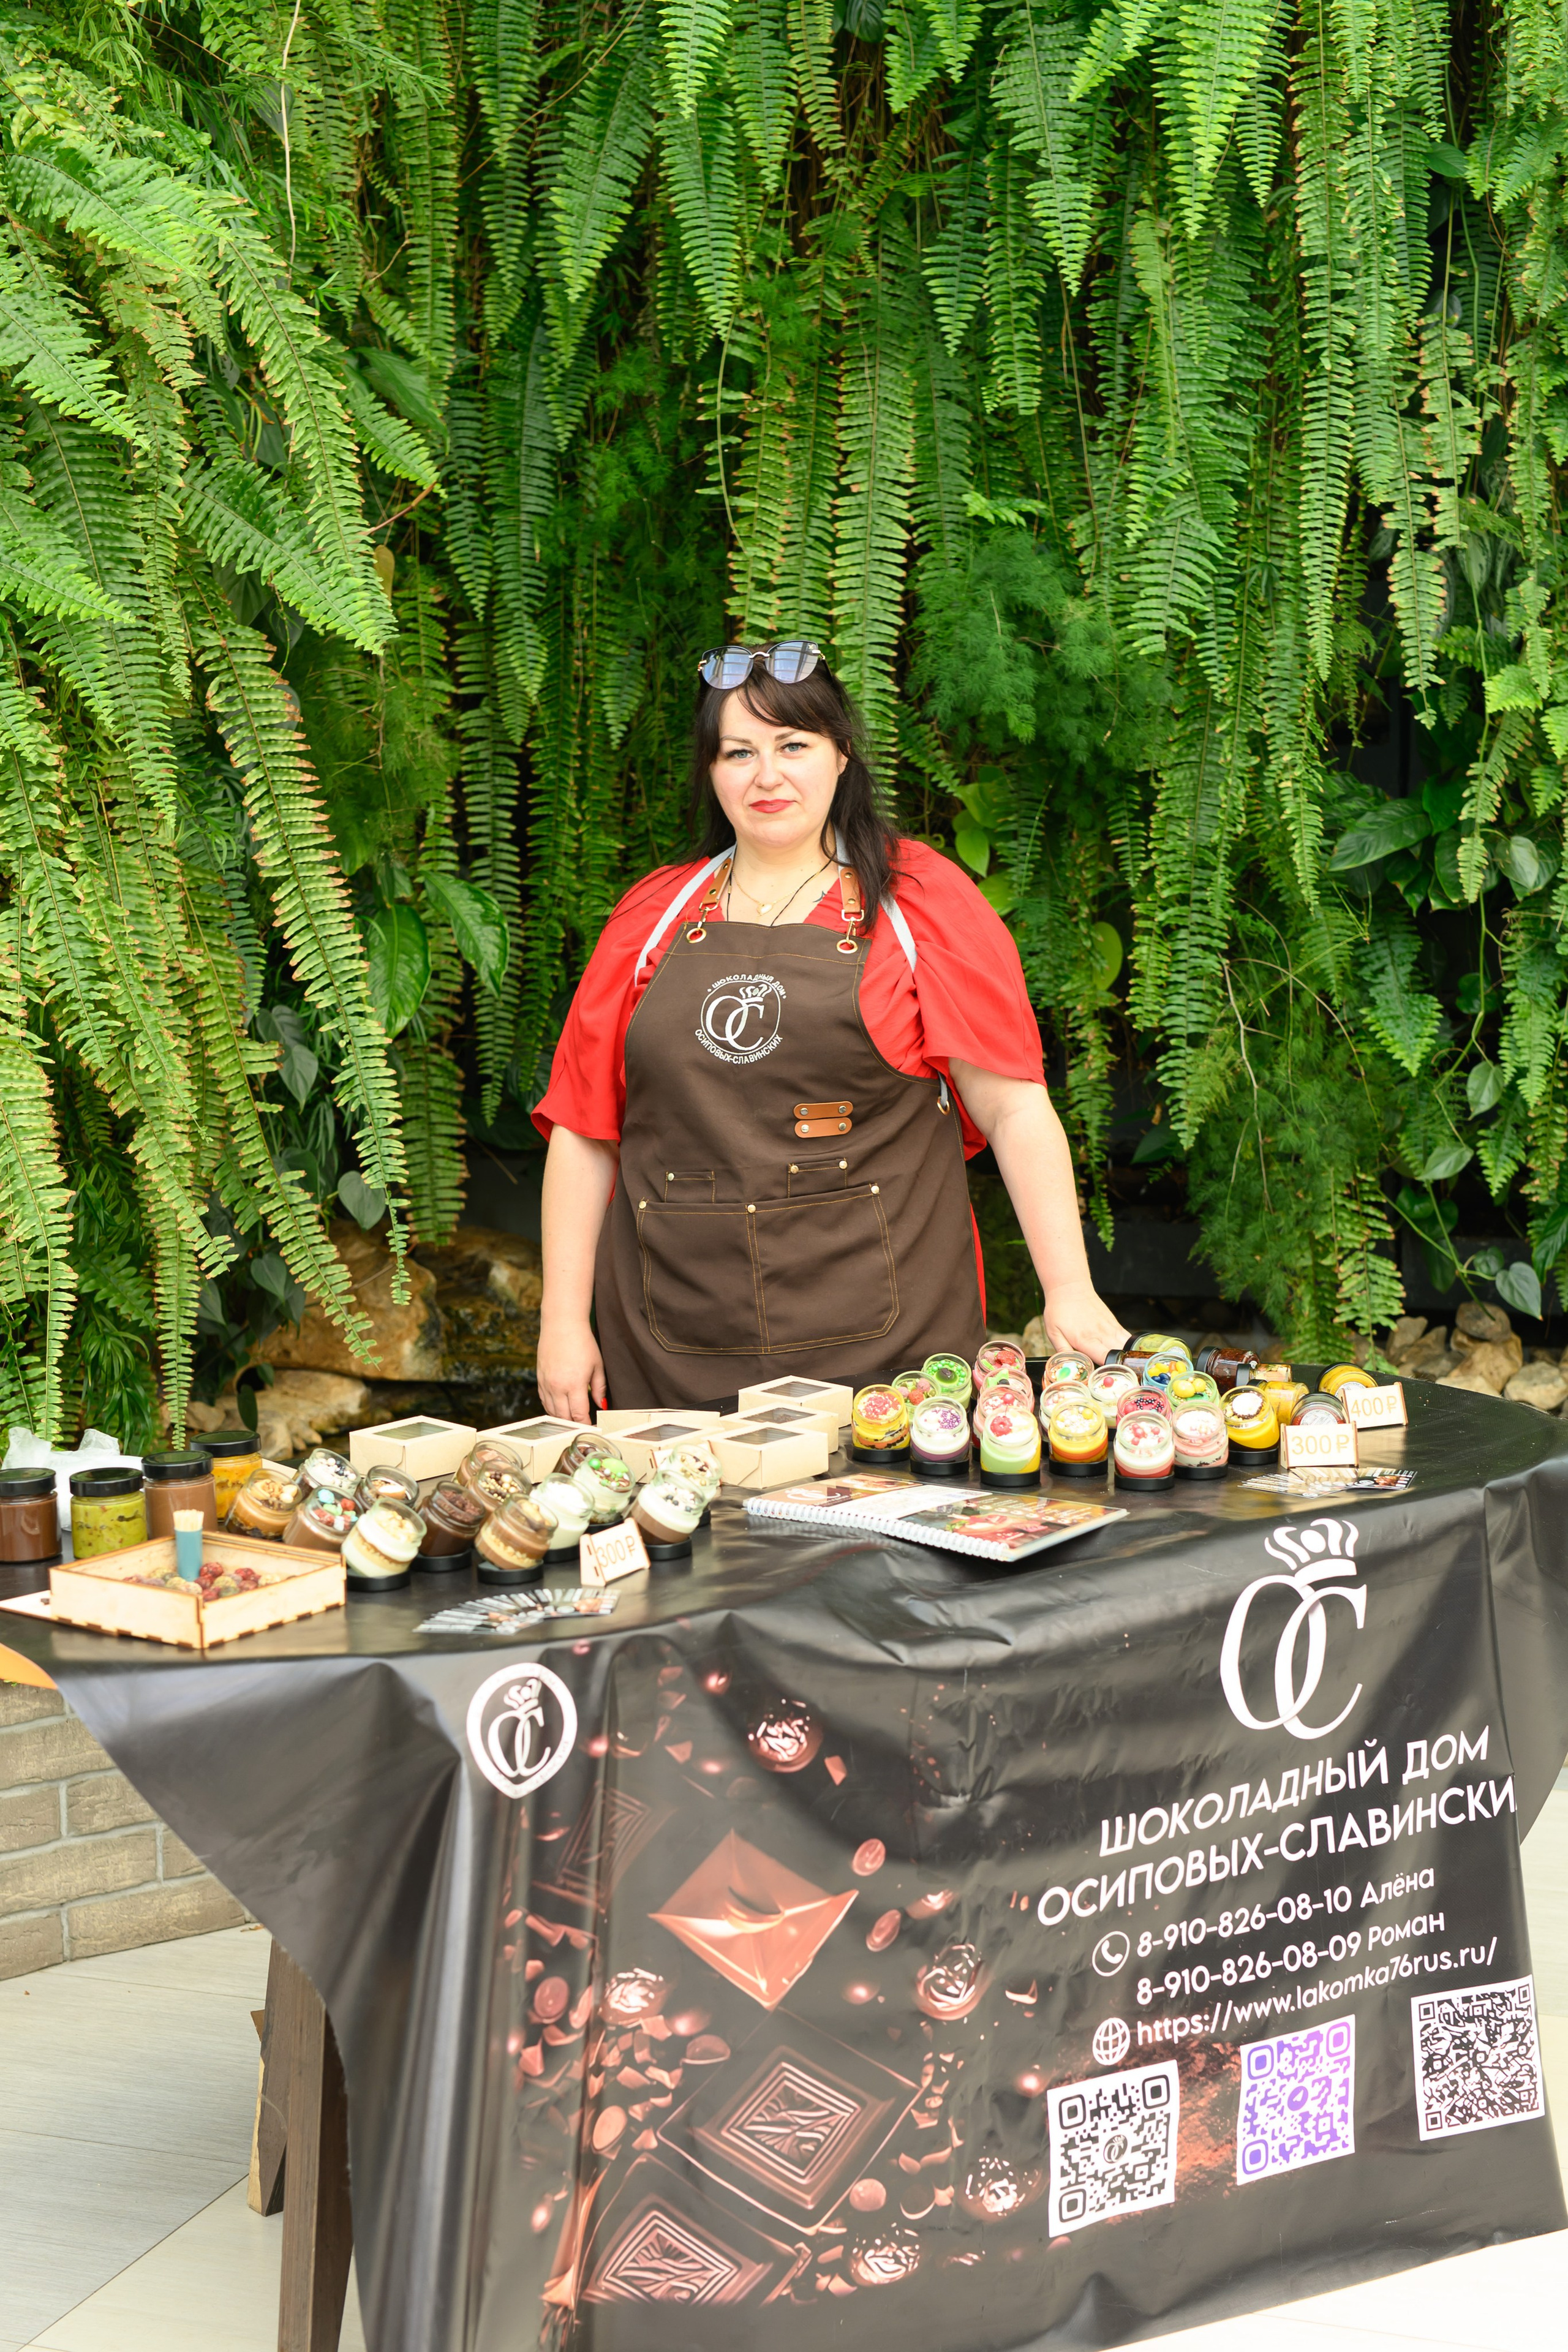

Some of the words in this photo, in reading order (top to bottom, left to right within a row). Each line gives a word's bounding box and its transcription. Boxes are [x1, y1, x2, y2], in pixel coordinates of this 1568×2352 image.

[772, 981, 786, 996] ДОМ
[695, 1029, 783, 1064] ОСИПОВЫХ-СЛАВИНСКИХ
[1099, 1739, 1389, 1857] ШОКОЛАДНЫЙ
[1402, 1725, 1489, 1785] ДОМ
[1038, 1776, 1517, 1926] ОСИПОВЫХ-СЛАВИНСКИ
[1137, 1886, 1352, 1958] 8-910-826-08-10
[1360, 1868, 1434, 1908] Алёна
[1137, 1931, 1361, 2005] 8-910-826-08-09
[1368, 1912, 1445, 1951] Роман
[1137, 1936, 1498, 2046] https://www.lakomka76rus.ru/
